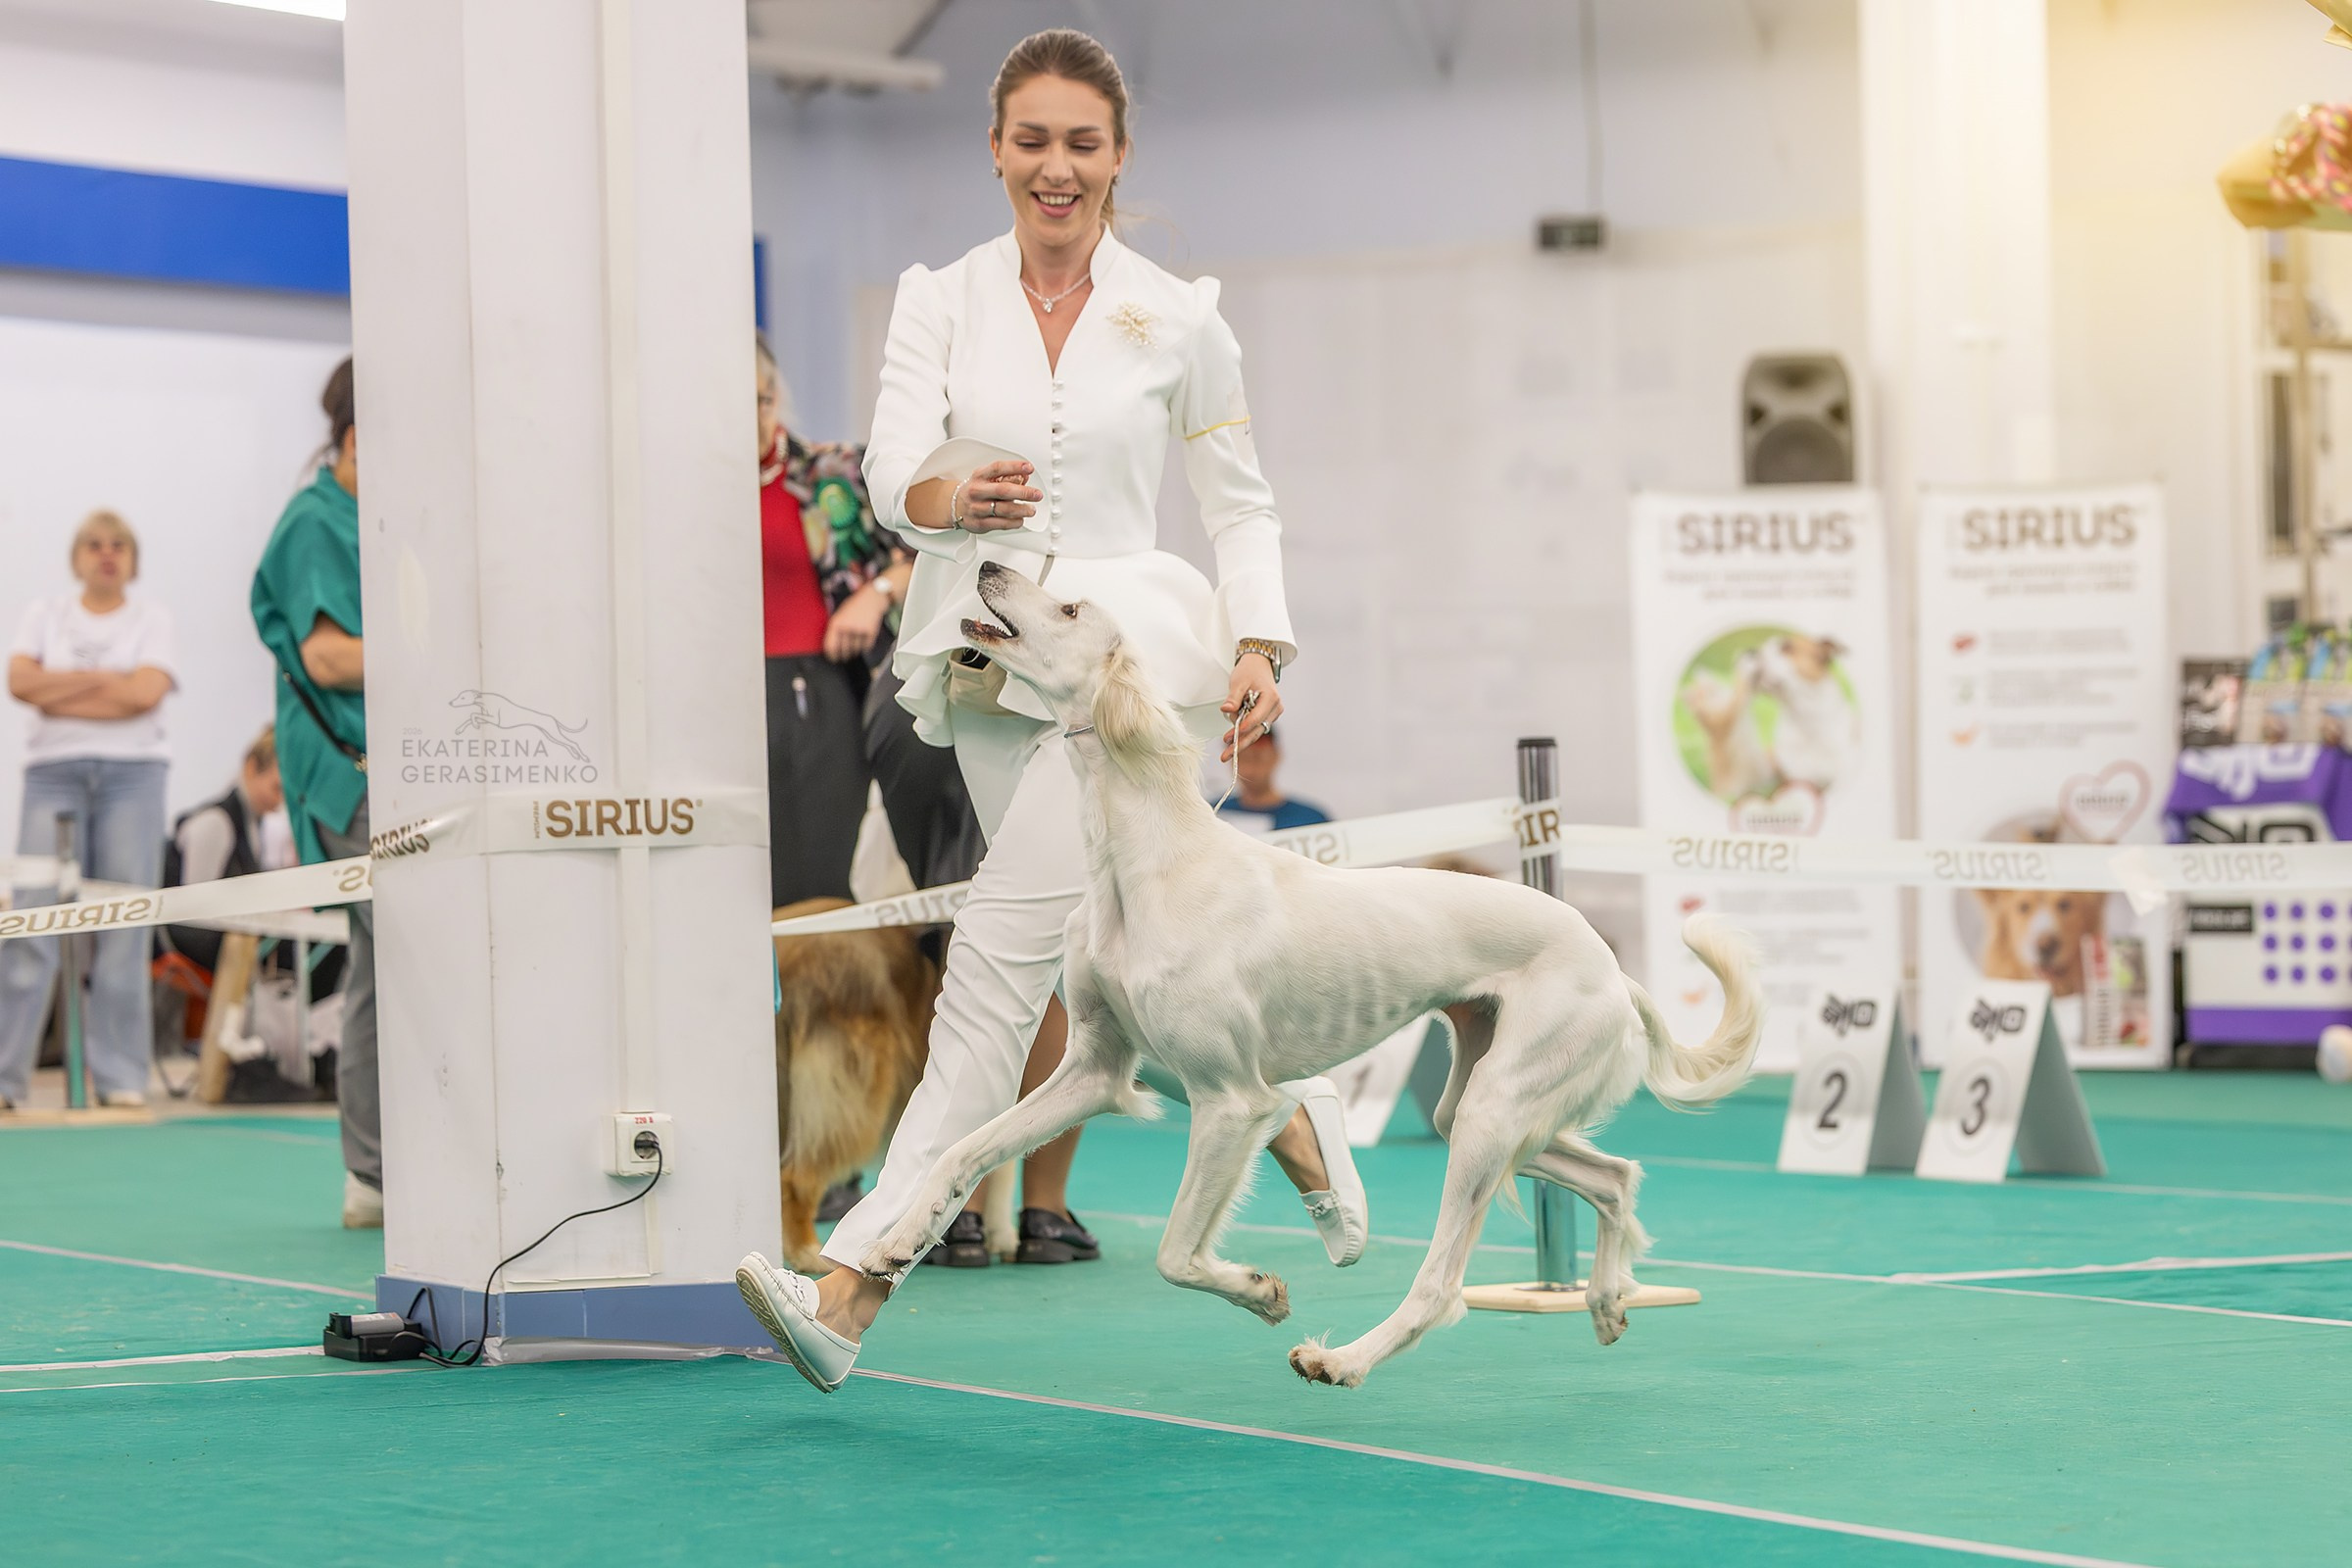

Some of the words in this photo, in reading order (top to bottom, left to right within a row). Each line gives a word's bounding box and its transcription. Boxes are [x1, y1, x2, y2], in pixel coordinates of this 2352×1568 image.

[1677, 512, 1855, 555] SIRIUS
[1962, 505, 2137, 551] SIRIUS
[546, 798, 695, 838] SIRIUS
[1818, 1070, 1847, 1129] 2
[1961, 1076, 1992, 1137] 3
